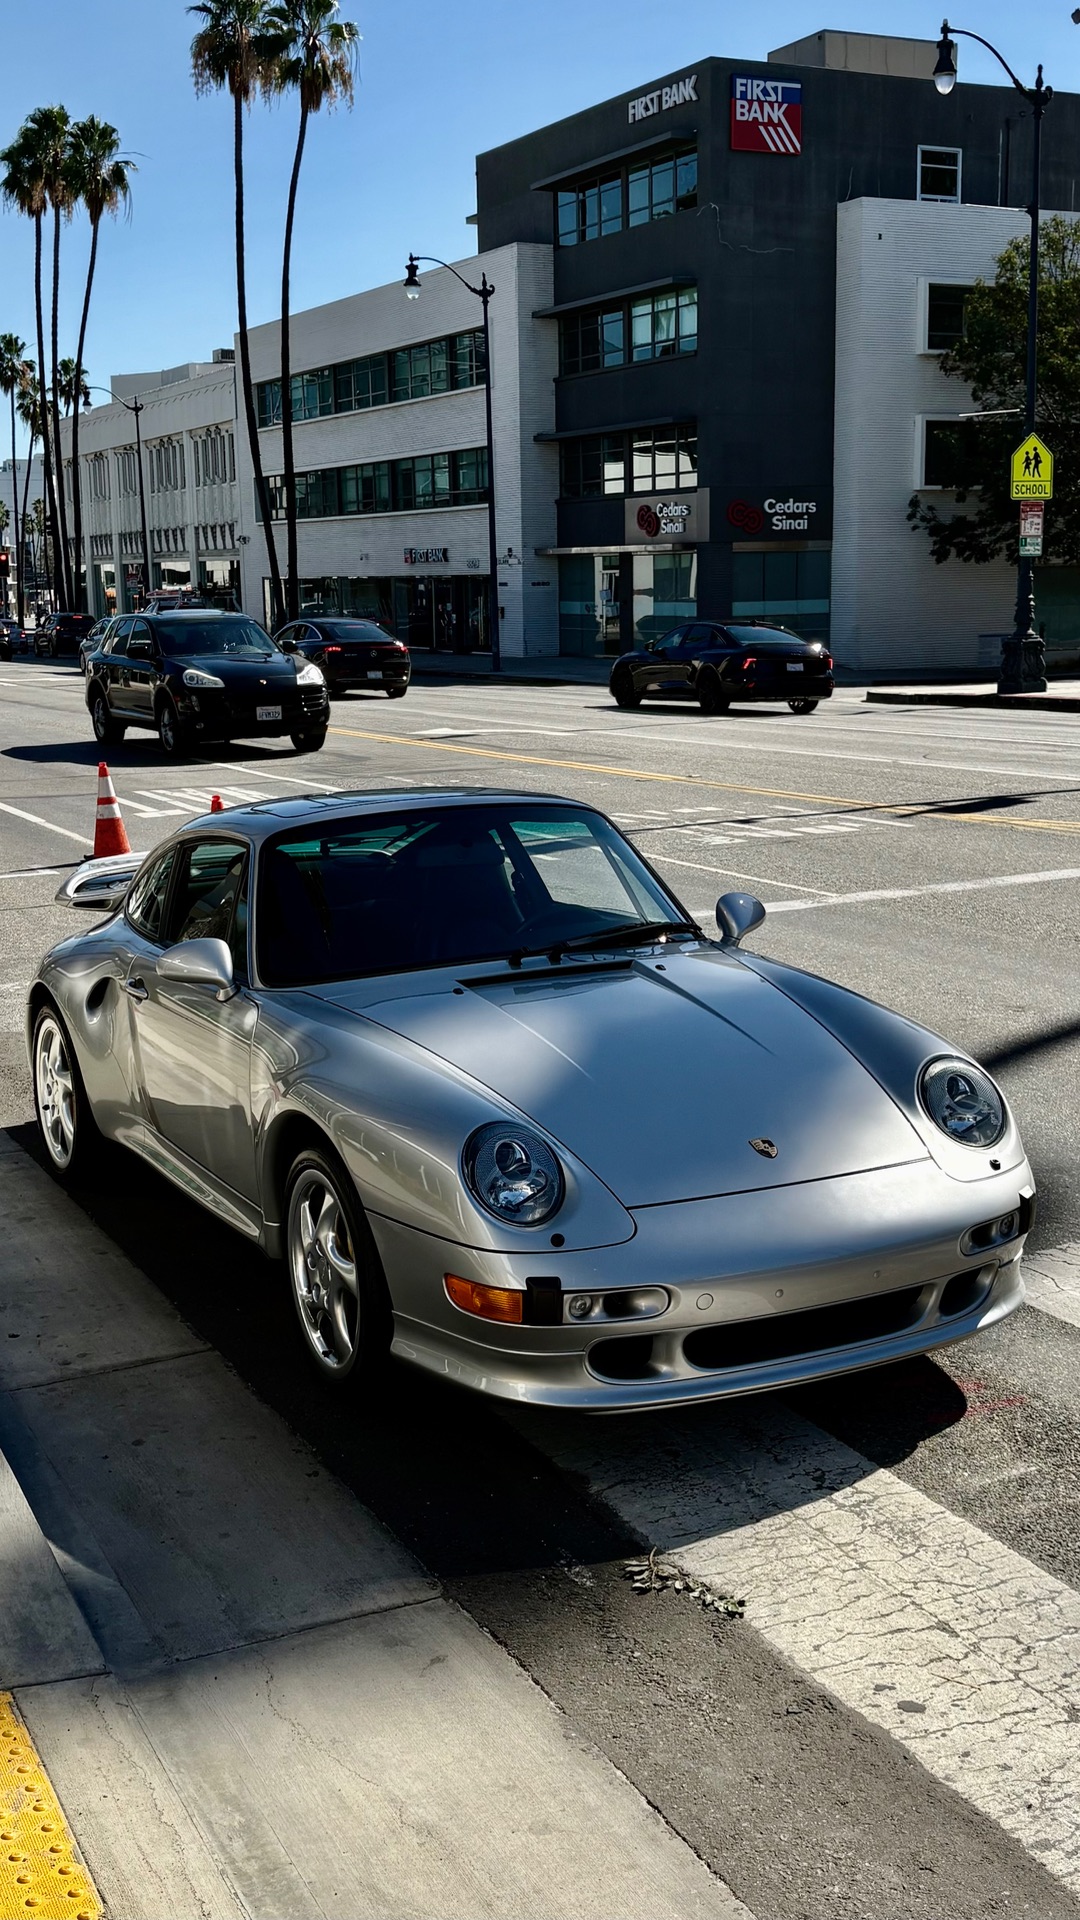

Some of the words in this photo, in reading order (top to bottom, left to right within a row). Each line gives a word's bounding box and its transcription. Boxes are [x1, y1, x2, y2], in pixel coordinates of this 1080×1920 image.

[735, 78, 801, 102] FIRST
[628, 90, 662, 124] FIRST
[662, 74, 698, 111] BANK
[735, 100, 789, 124] BANK
[1014, 484, 1049, 495] SCHOOL
[656, 502, 689, 517] Cedars
[763, 498, 817, 514] Cedars
[660, 519, 683, 534] Sinai
[771, 515, 808, 531] Sinai
[411, 549, 428, 563] FIRST
[428, 548, 445, 562] BANK
